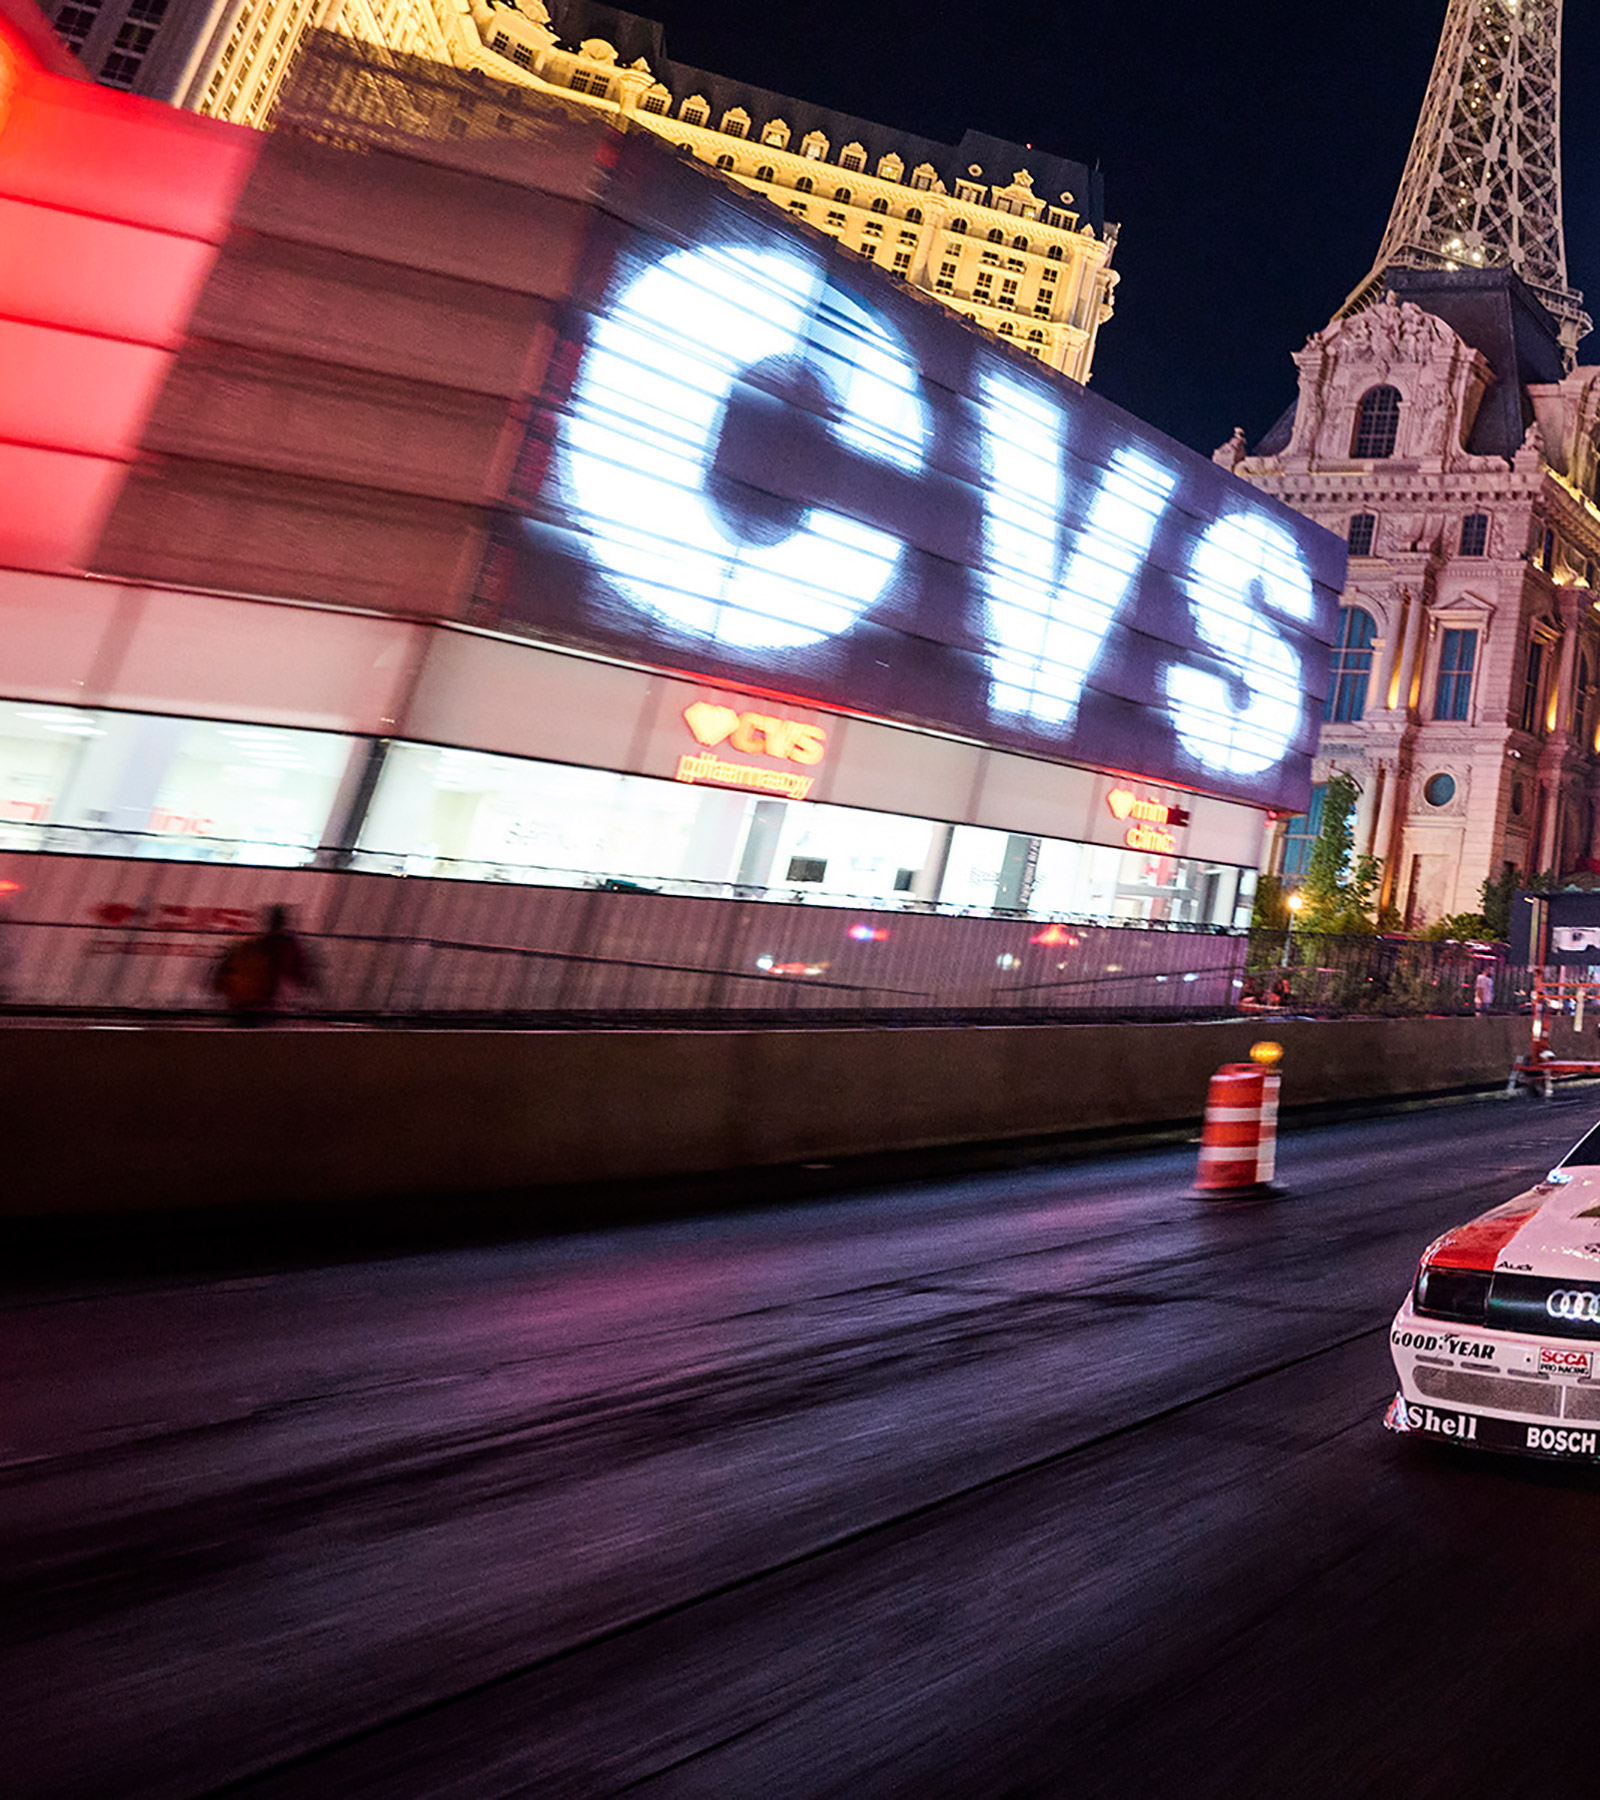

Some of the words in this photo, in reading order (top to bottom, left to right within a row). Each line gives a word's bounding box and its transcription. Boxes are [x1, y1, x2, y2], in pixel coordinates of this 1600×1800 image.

[564, 244, 1316, 778] CVS
[729, 711, 828, 766] CVS
[675, 751, 815, 800] pharmacy
[1497, 1261, 1533, 1271] Audi
[1541, 1350, 1588, 1366] SCCA
[1407, 1405, 1477, 1440] Shell
[1526, 1427, 1597, 1453] BOSCH
